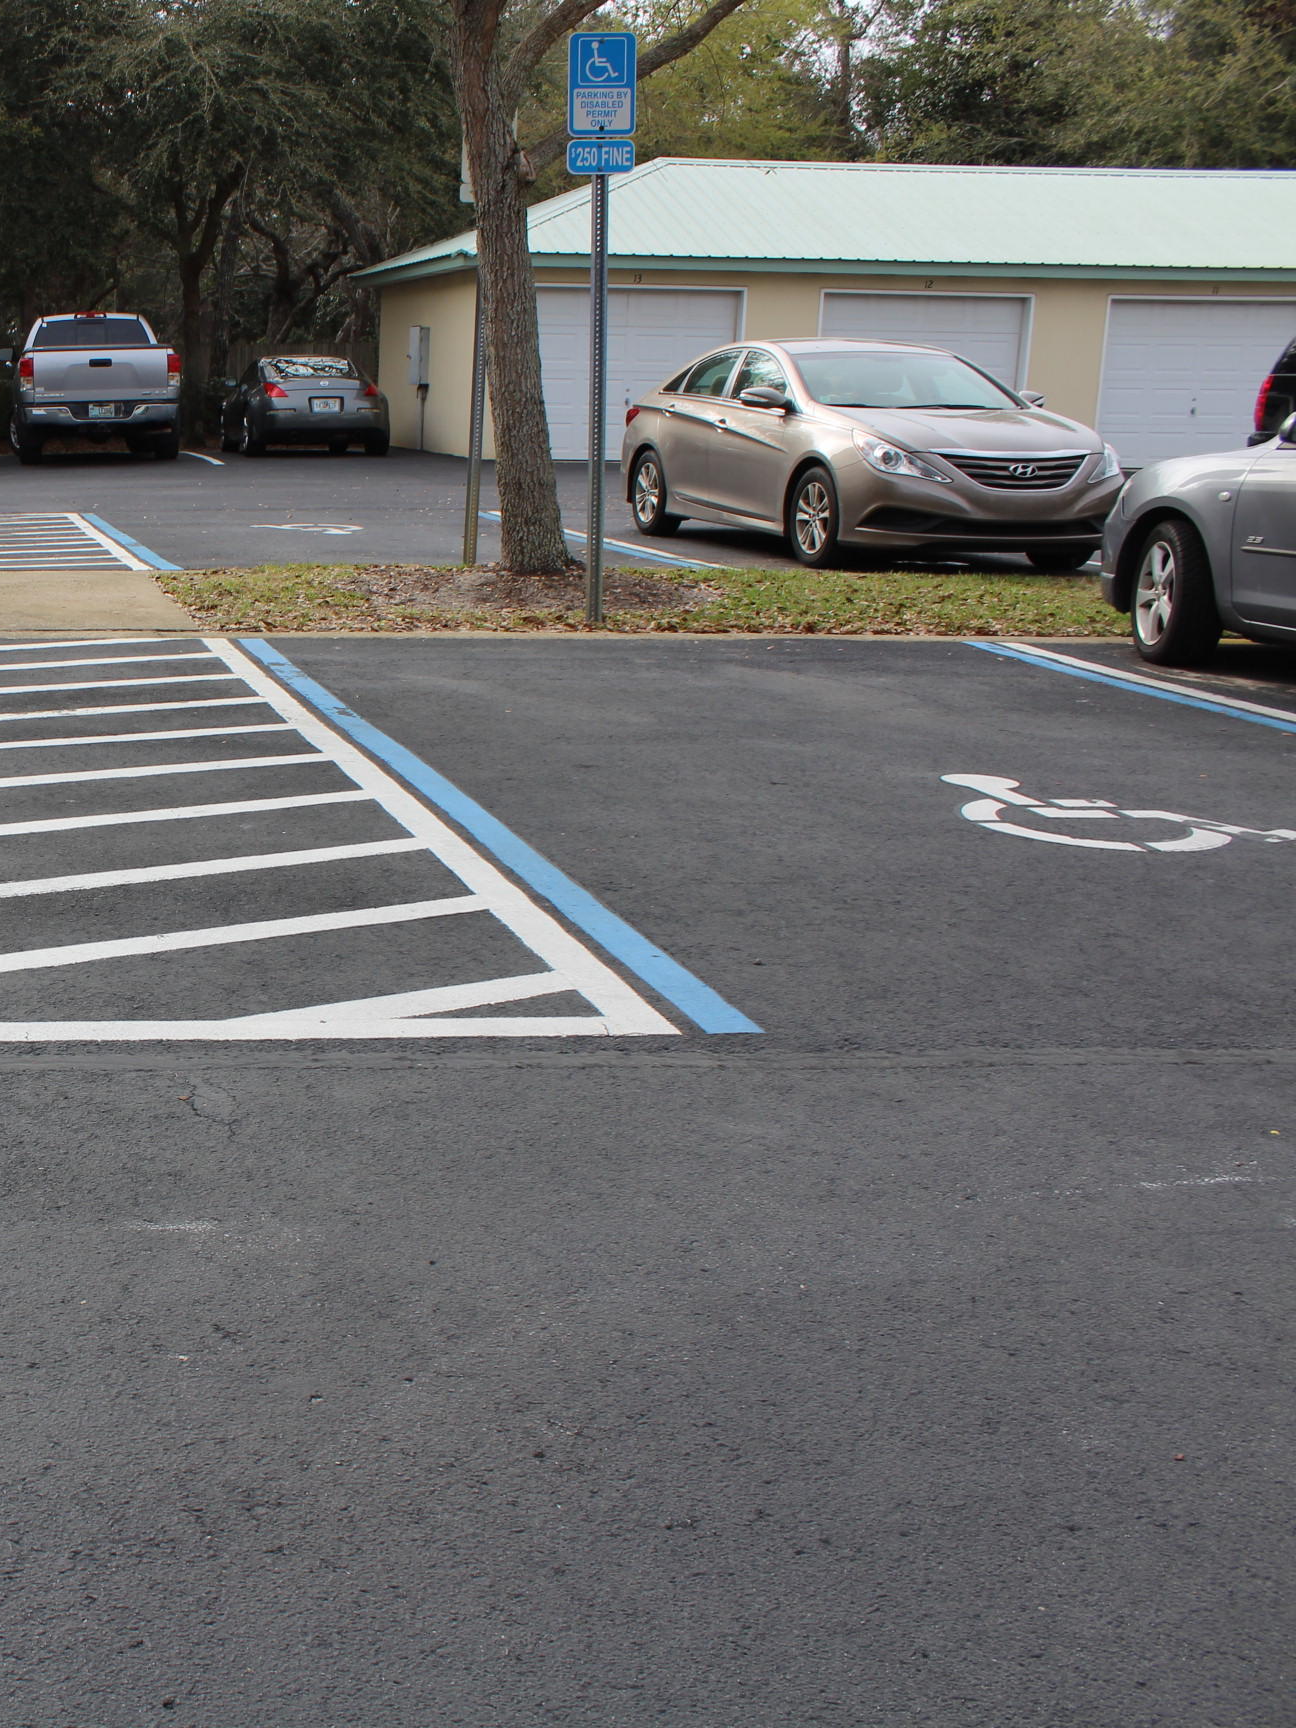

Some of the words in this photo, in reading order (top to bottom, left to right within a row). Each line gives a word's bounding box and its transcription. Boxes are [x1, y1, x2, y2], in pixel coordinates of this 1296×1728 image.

[576, 91, 614, 99] PARKING
[616, 91, 629, 99] BY
[580, 101, 624, 109] DISABLED
[586, 110, 617, 118] PERMIT
[590, 119, 613, 128] ONLY
[571, 147, 598, 167] $250
[601, 146, 631, 166] FINE
